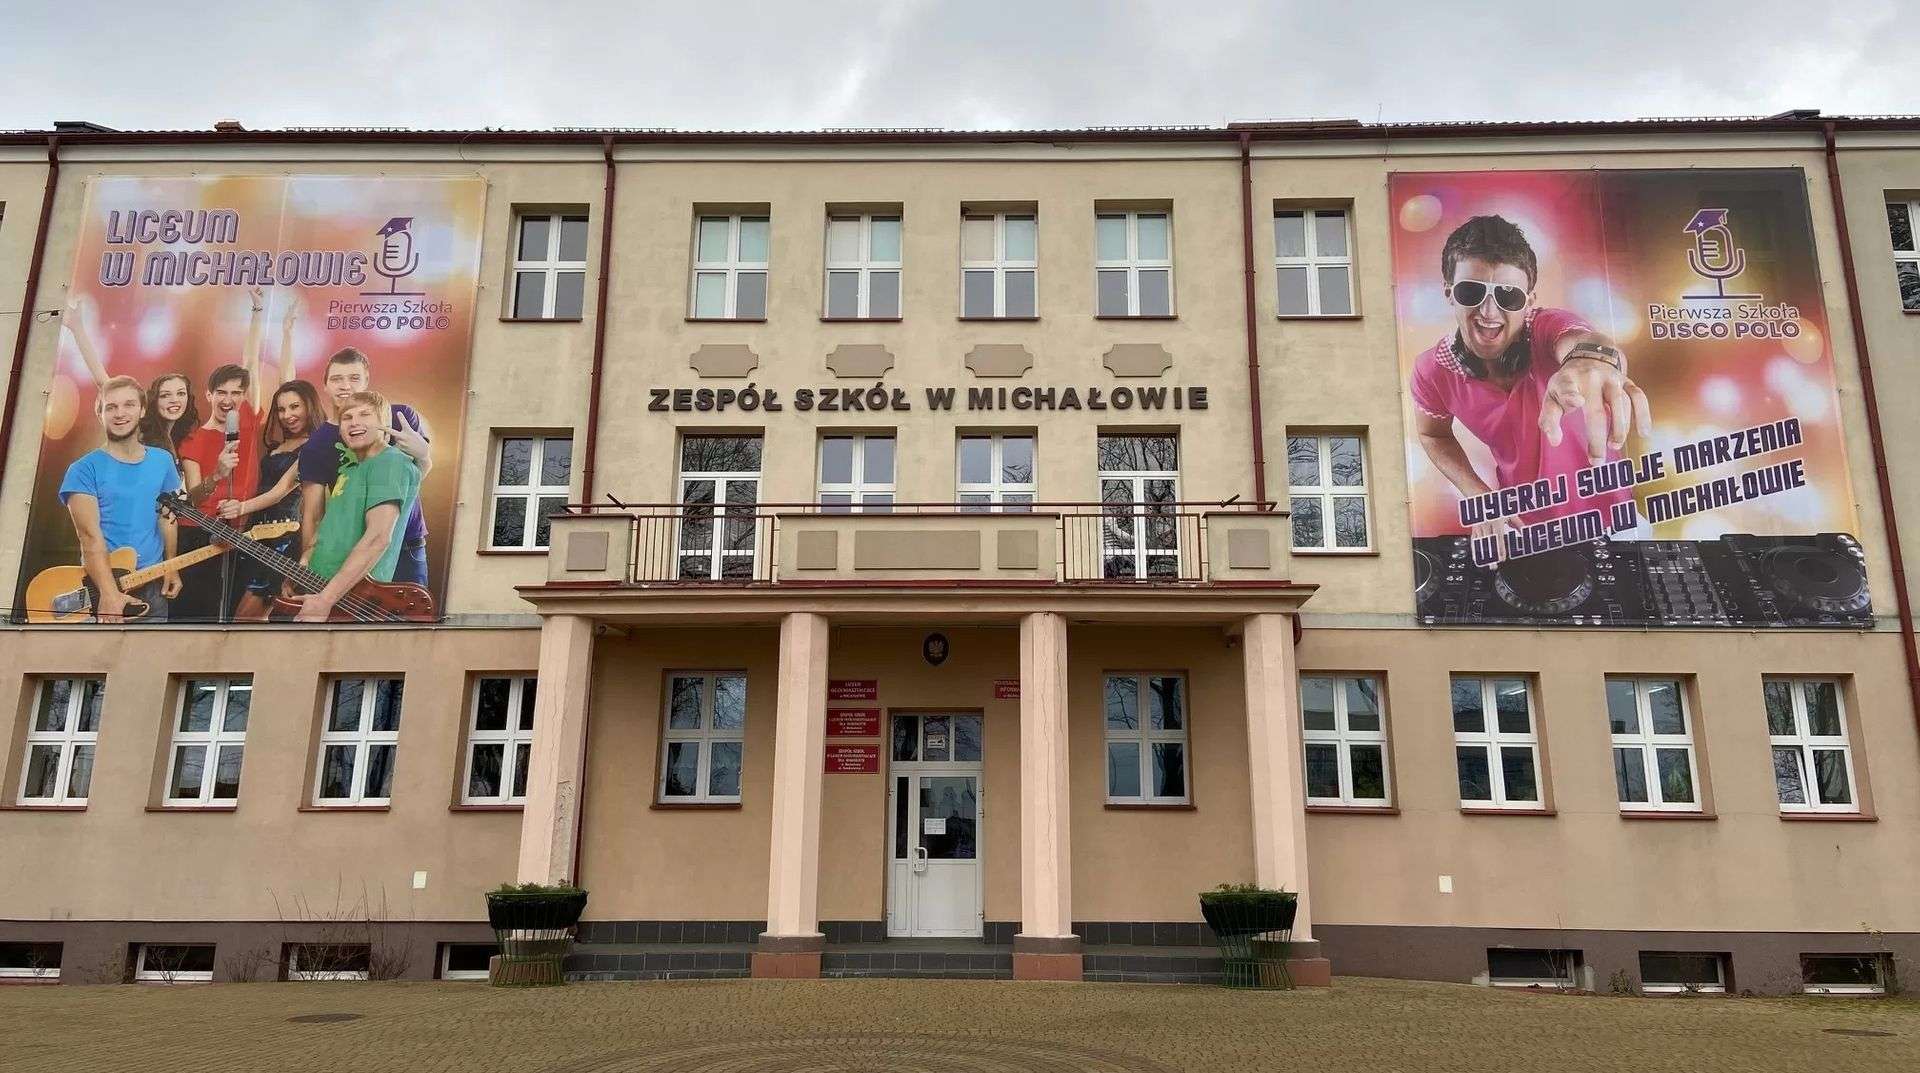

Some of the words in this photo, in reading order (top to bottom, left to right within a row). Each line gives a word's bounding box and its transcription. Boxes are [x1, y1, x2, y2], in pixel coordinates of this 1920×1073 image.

[106, 208, 240, 244] LICEUM
[100, 251, 134, 287] W
[142, 250, 368, 287] MICHAŁOWIE
[329, 300, 398, 314] Pierwsza
[403, 299, 453, 314] Szkoła
[1650, 304, 1732, 320] Pierwsza
[1738, 304, 1800, 320] Szkoła
[327, 316, 392, 330] DISCO
[396, 316, 450, 330] POLO
[1652, 322, 1729, 338] DISCO
[1735, 322, 1800, 338] POLO
[648, 383, 783, 412] ZESPÓŁ
[794, 382, 911, 412] SZKÓŁ
[925, 387, 956, 411] W
[968, 386, 1209, 410] MICHAŁOWIE
[1459, 475, 1568, 526] WYGRAJ
[1577, 452, 1665, 497] SWOJE
[1674, 417, 1802, 474] MARZENIA
[1474, 536, 1499, 567] W
[1505, 510, 1601, 559] LICEUM
[1611, 501, 1638, 533] W
[1646, 459, 1806, 524] MICHAŁOWIE
